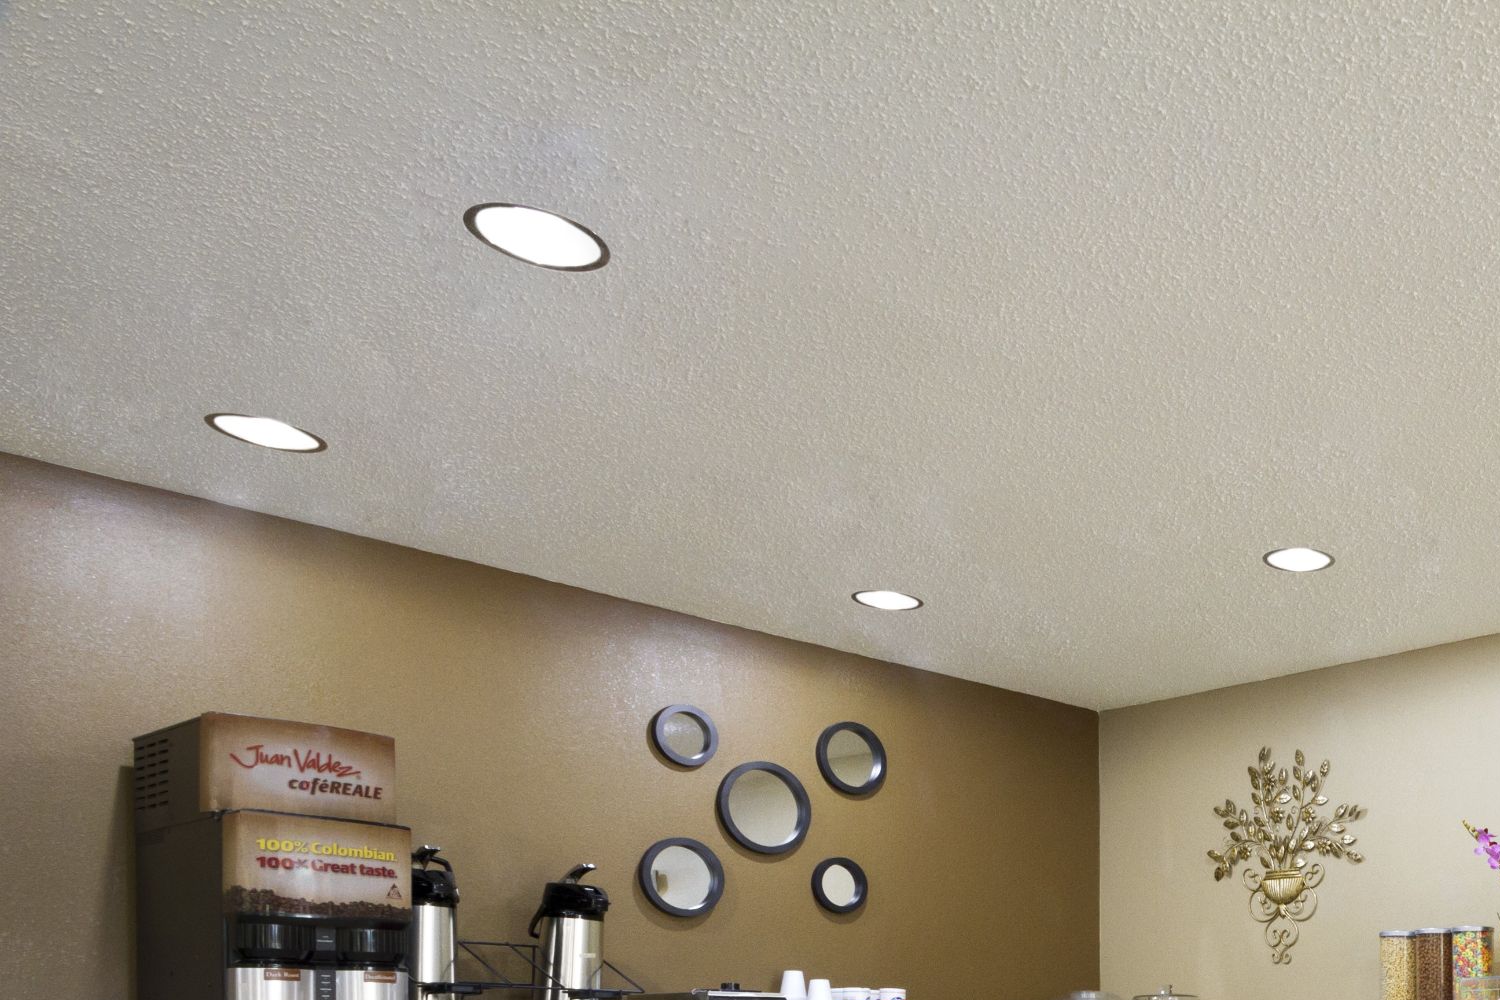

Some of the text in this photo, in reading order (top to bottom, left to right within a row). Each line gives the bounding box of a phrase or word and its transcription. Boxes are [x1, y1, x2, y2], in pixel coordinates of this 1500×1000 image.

[229, 744, 361, 778] Juan Valdez
[256, 838, 308, 853] 100%
[256, 855, 398, 879] 100% Great taste.
